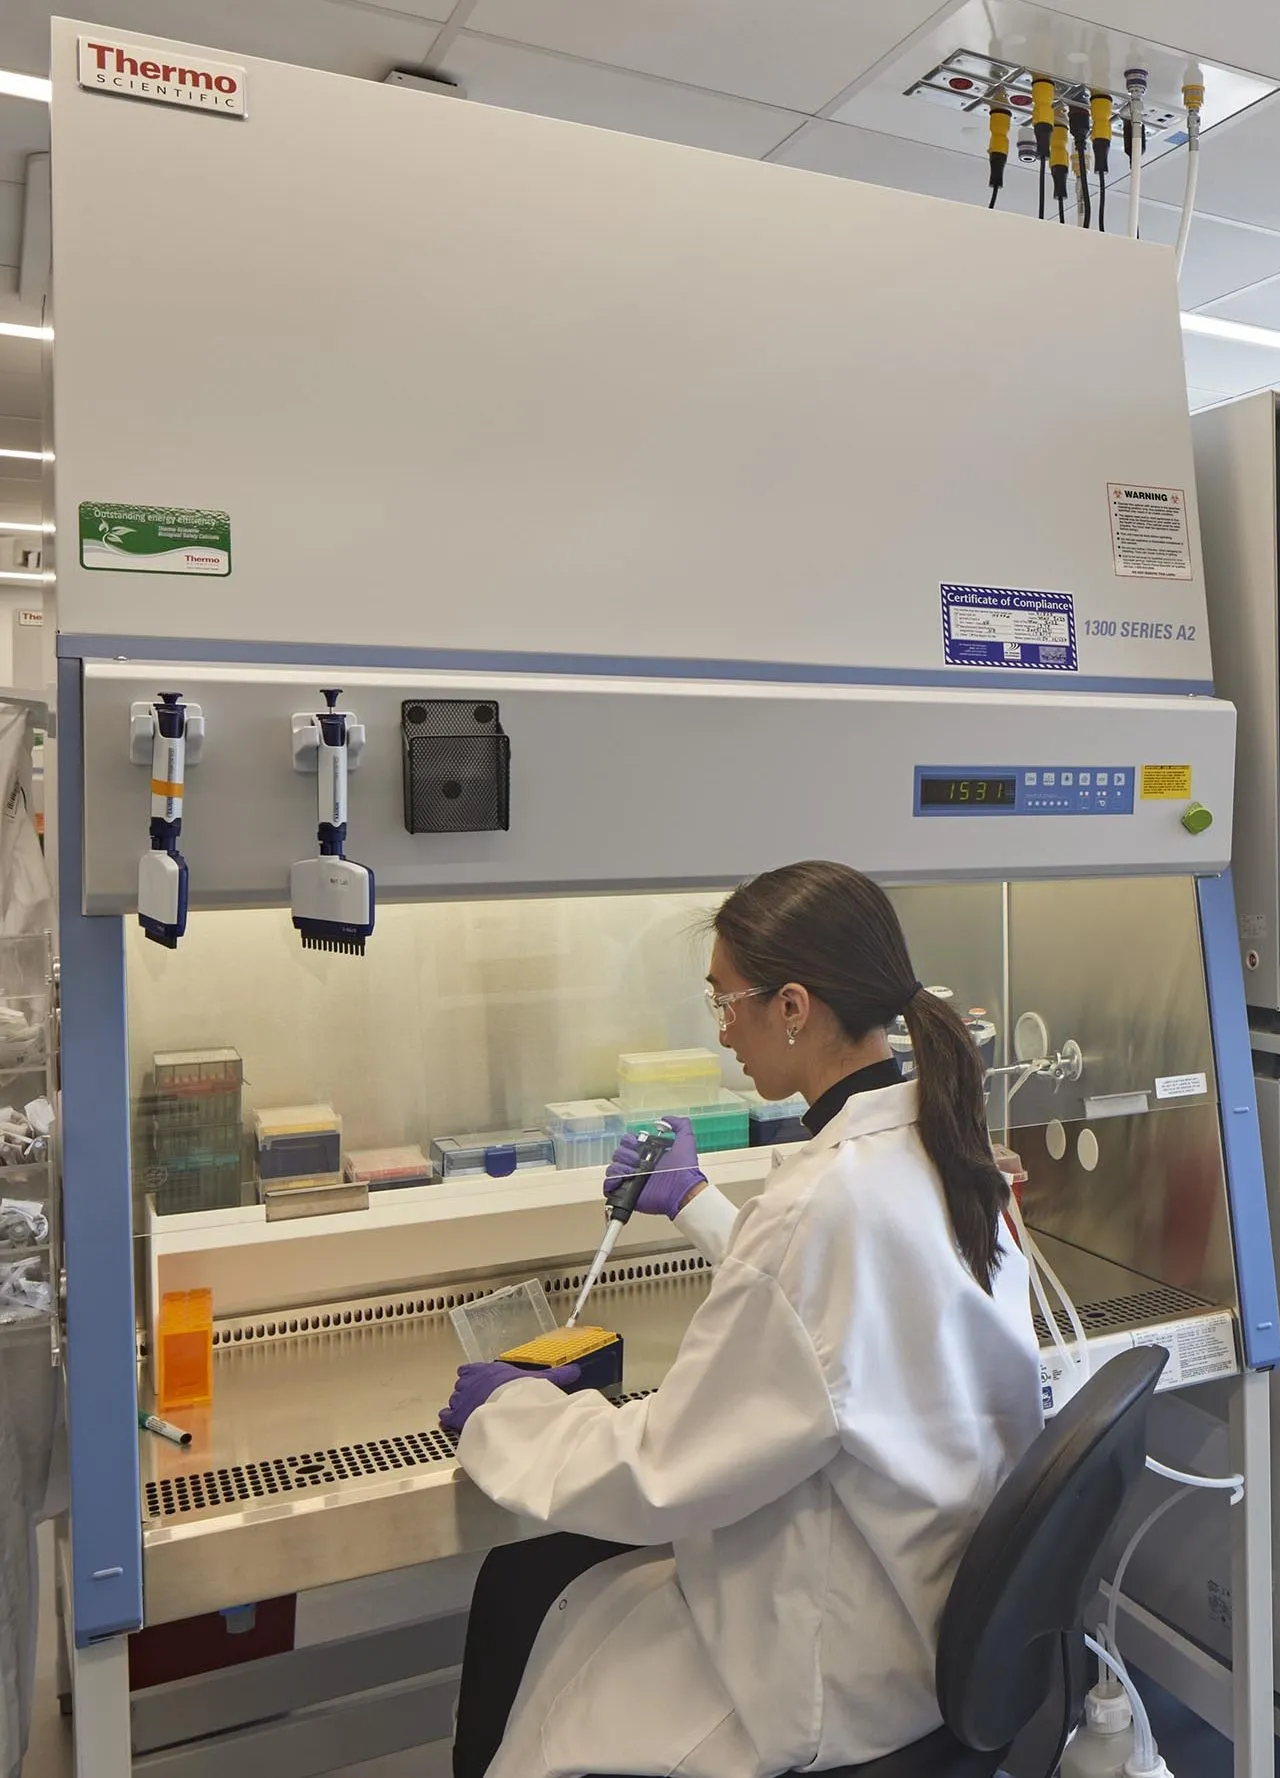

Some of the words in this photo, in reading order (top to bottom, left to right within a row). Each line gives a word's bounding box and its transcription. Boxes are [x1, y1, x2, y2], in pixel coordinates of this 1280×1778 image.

[88, 43, 237, 94] Thermo
[96, 73, 235, 108] SCIENTIFIC
[1124, 490, 1168, 501] WARNING
[94, 509, 146, 522] Outstanding
[147, 514, 176, 524] energy
[177, 516, 217, 526] efficiency
[185, 554, 220, 564] Thermo
[947, 592, 998, 605] Certificate
[1000, 596, 1011, 606] of
[1013, 598, 1069, 611] Compliance
[1084, 619, 1117, 637] 1300
[1120, 621, 1173, 640] SERIES
[1176, 625, 1197, 642] A2
